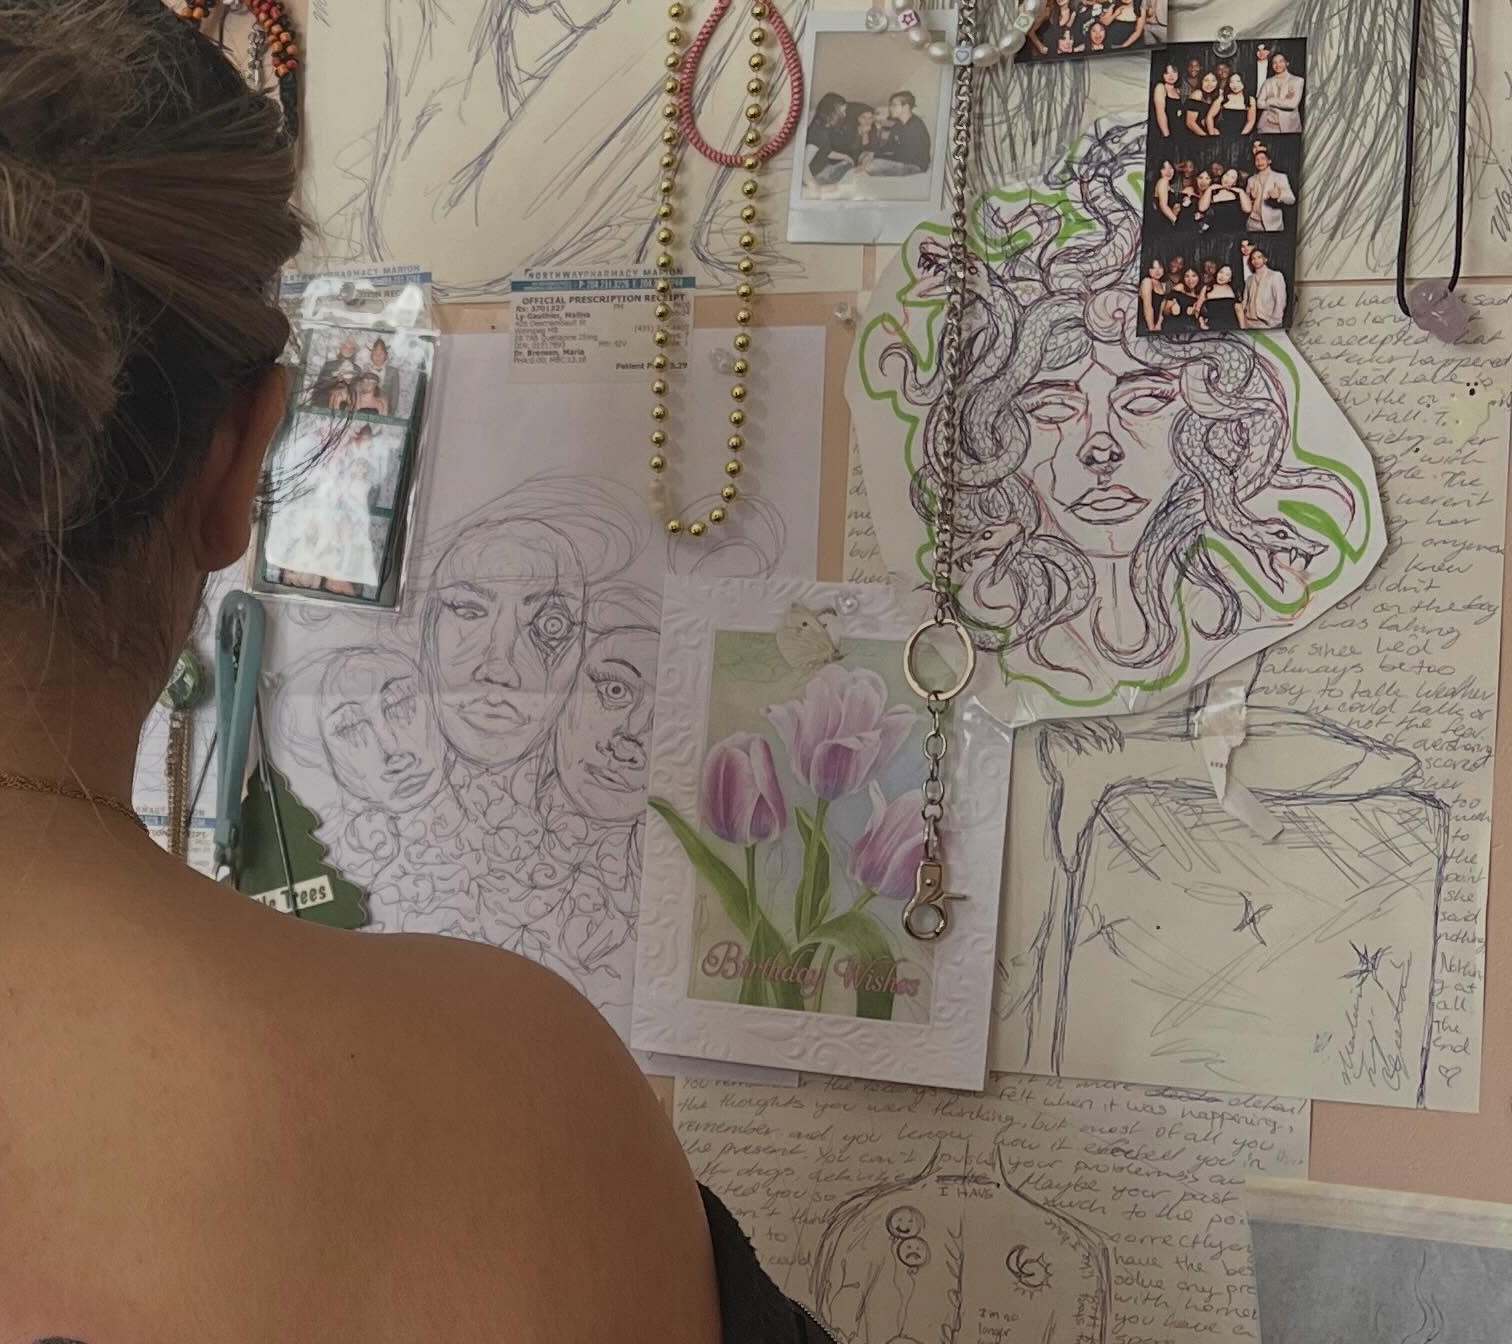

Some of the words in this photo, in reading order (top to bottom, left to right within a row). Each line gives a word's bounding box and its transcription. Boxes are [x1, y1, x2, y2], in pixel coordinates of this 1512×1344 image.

[522, 295, 566, 306] OFFICIAL
[569, 293, 641, 305] PRESCRIPTION
[701, 940, 825, 999] Birthday
[833, 956, 922, 998] Wishes
